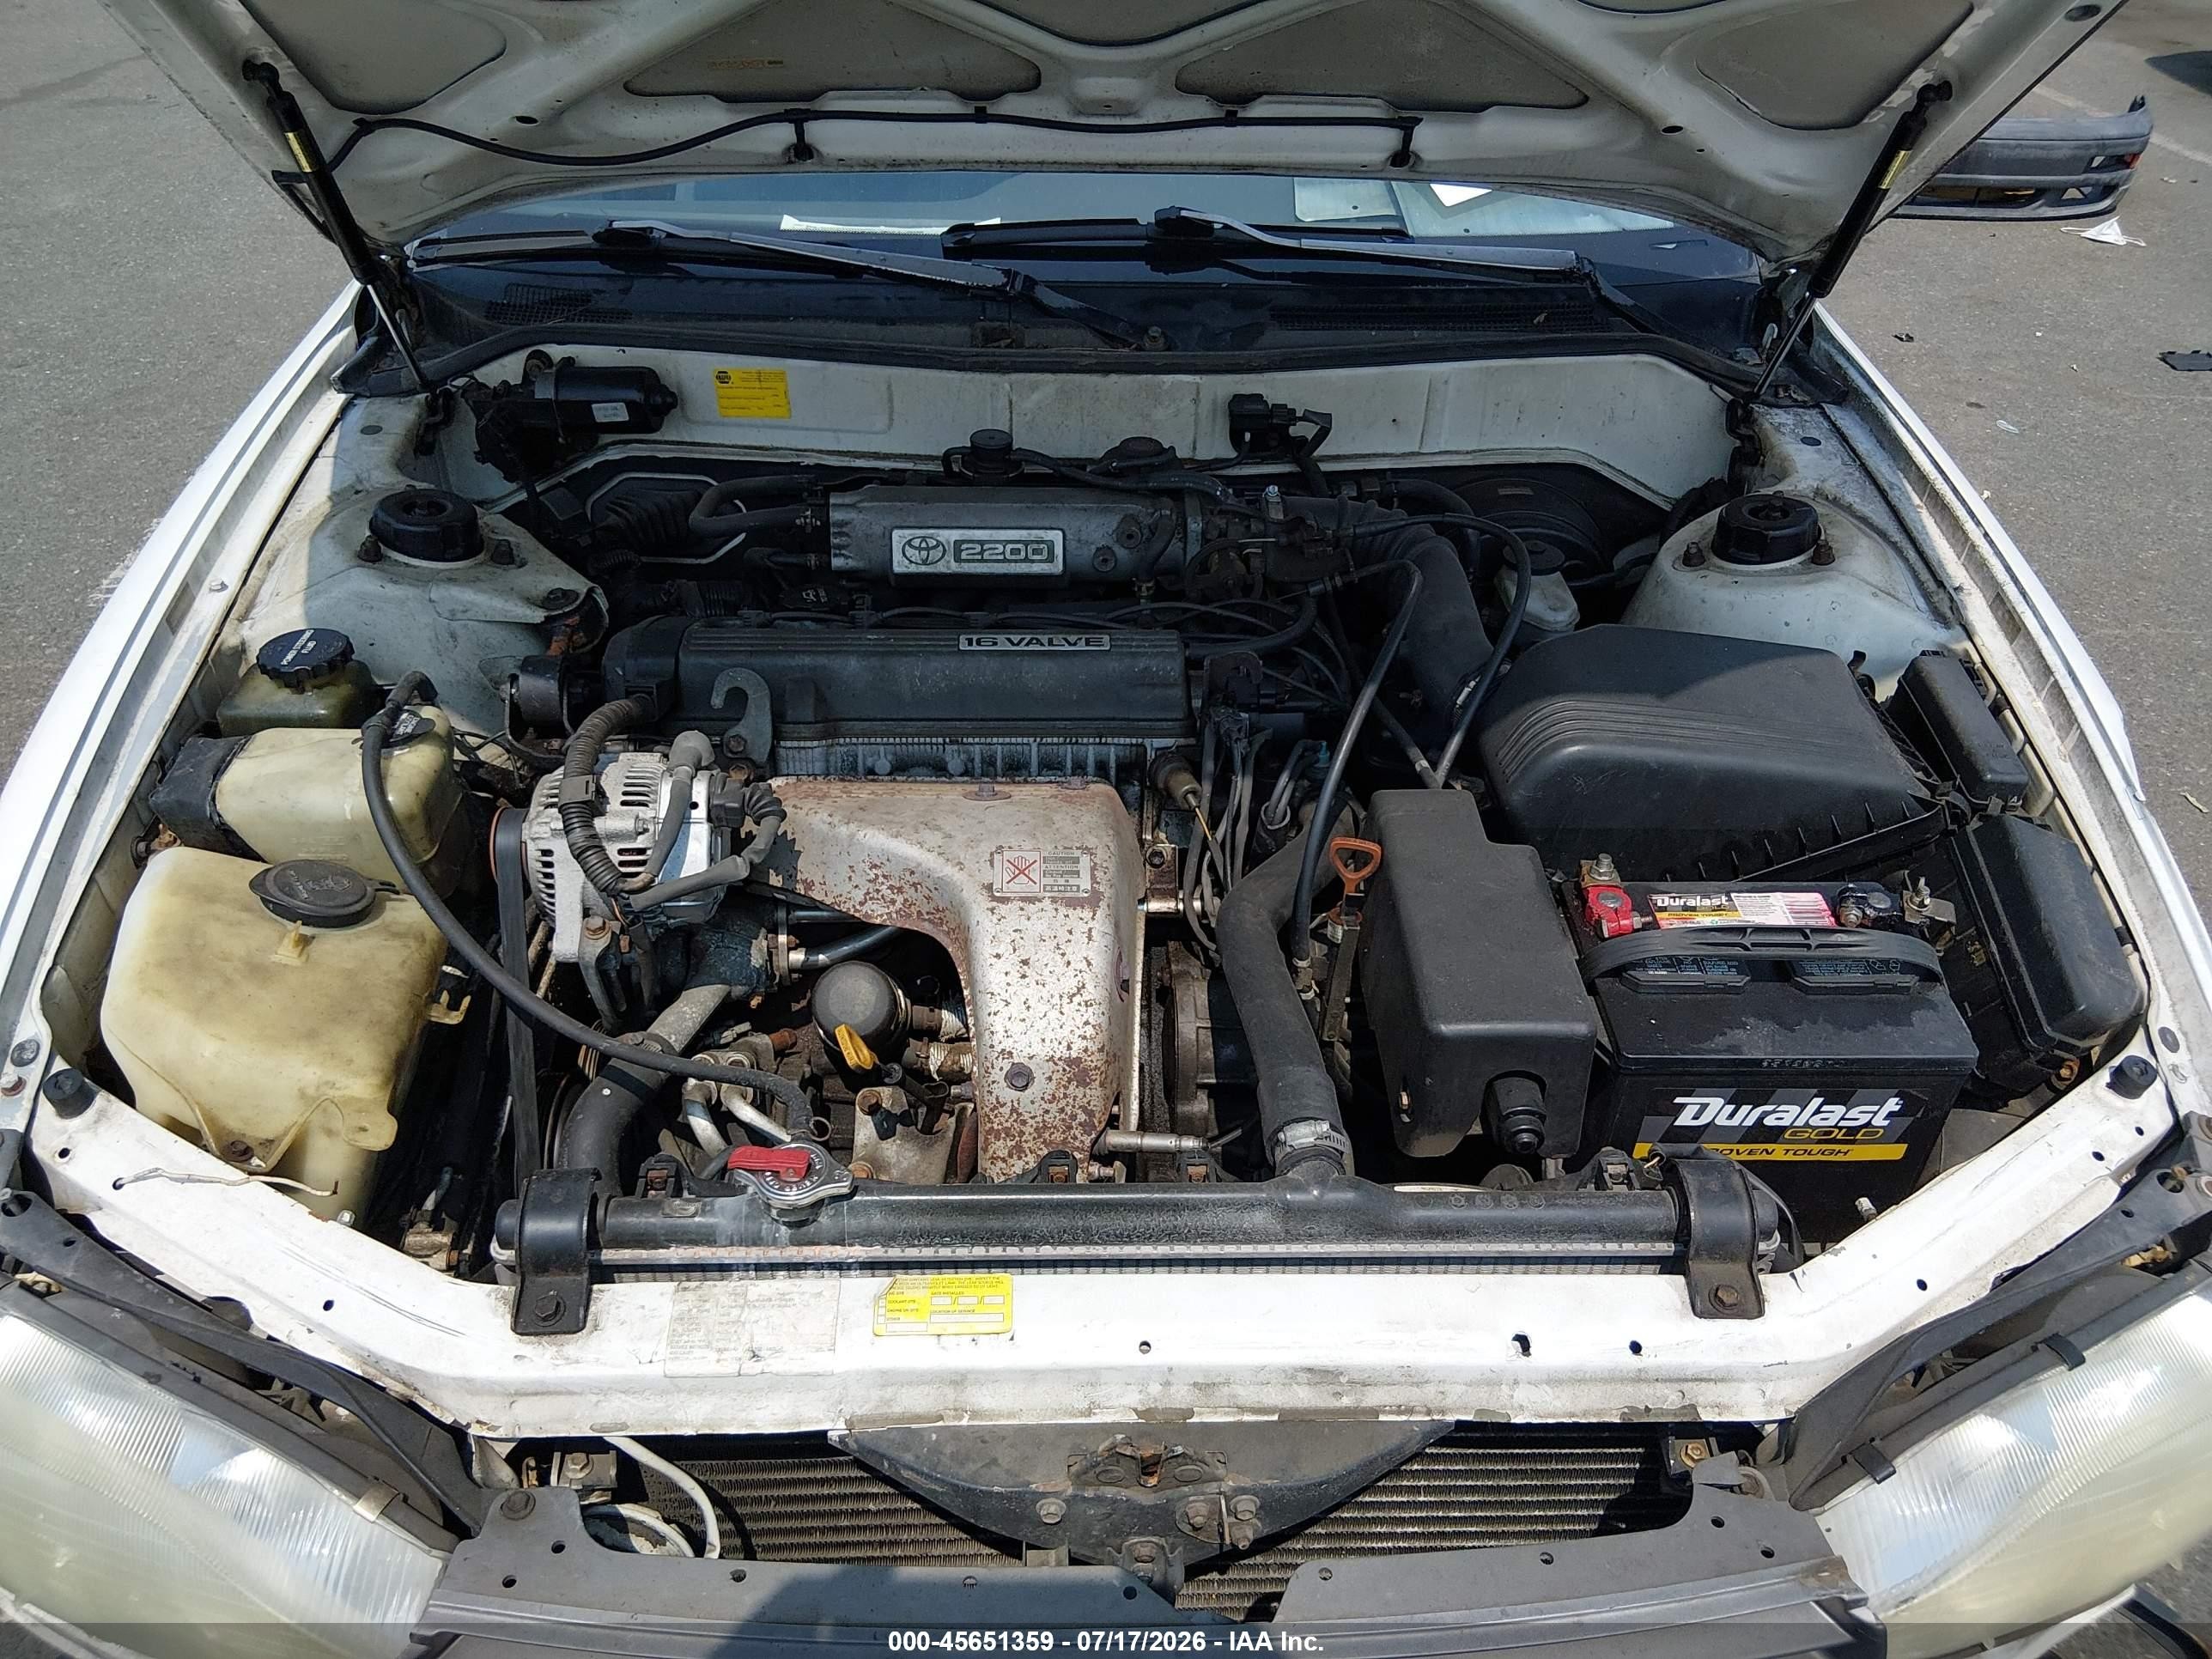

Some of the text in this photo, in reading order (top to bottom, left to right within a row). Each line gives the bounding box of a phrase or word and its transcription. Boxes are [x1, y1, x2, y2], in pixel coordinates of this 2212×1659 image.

[959, 543, 1048, 560] 2200
[964, 636, 1105, 647] 16 VALVE
[1650, 896, 1729, 907] Duralast
[1673, 1097, 1903, 1127] Duralast
[1783, 1127, 1885, 1140] GOLD
[1712, 1148, 1850, 1157] OVEN TOUGH
